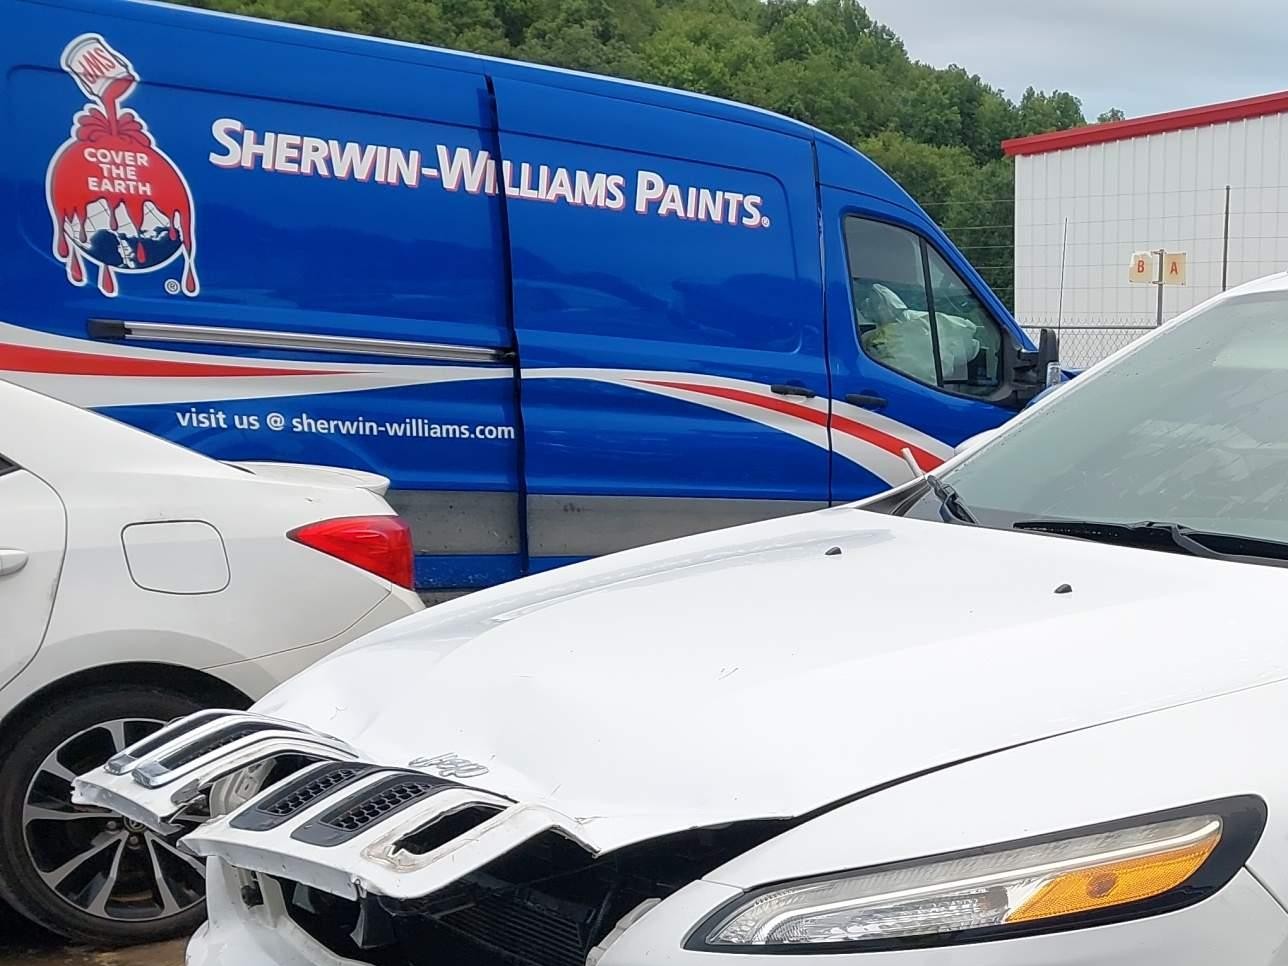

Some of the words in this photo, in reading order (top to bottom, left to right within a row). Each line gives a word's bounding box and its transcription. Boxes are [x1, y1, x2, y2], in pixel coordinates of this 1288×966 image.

[83, 147, 149, 167] COVER
[208, 117, 626, 211] SHERWIN-WILLIAMS
[97, 163, 138, 180] THE
[87, 176, 153, 197] EARTH
[1137, 260, 1145, 273] B
[1169, 262, 1179, 275] A
[176, 408, 226, 429] visit
[233, 414, 260, 430] us
[266, 412, 285, 431] @
[292, 413, 516, 440] sherwin-williams.com
